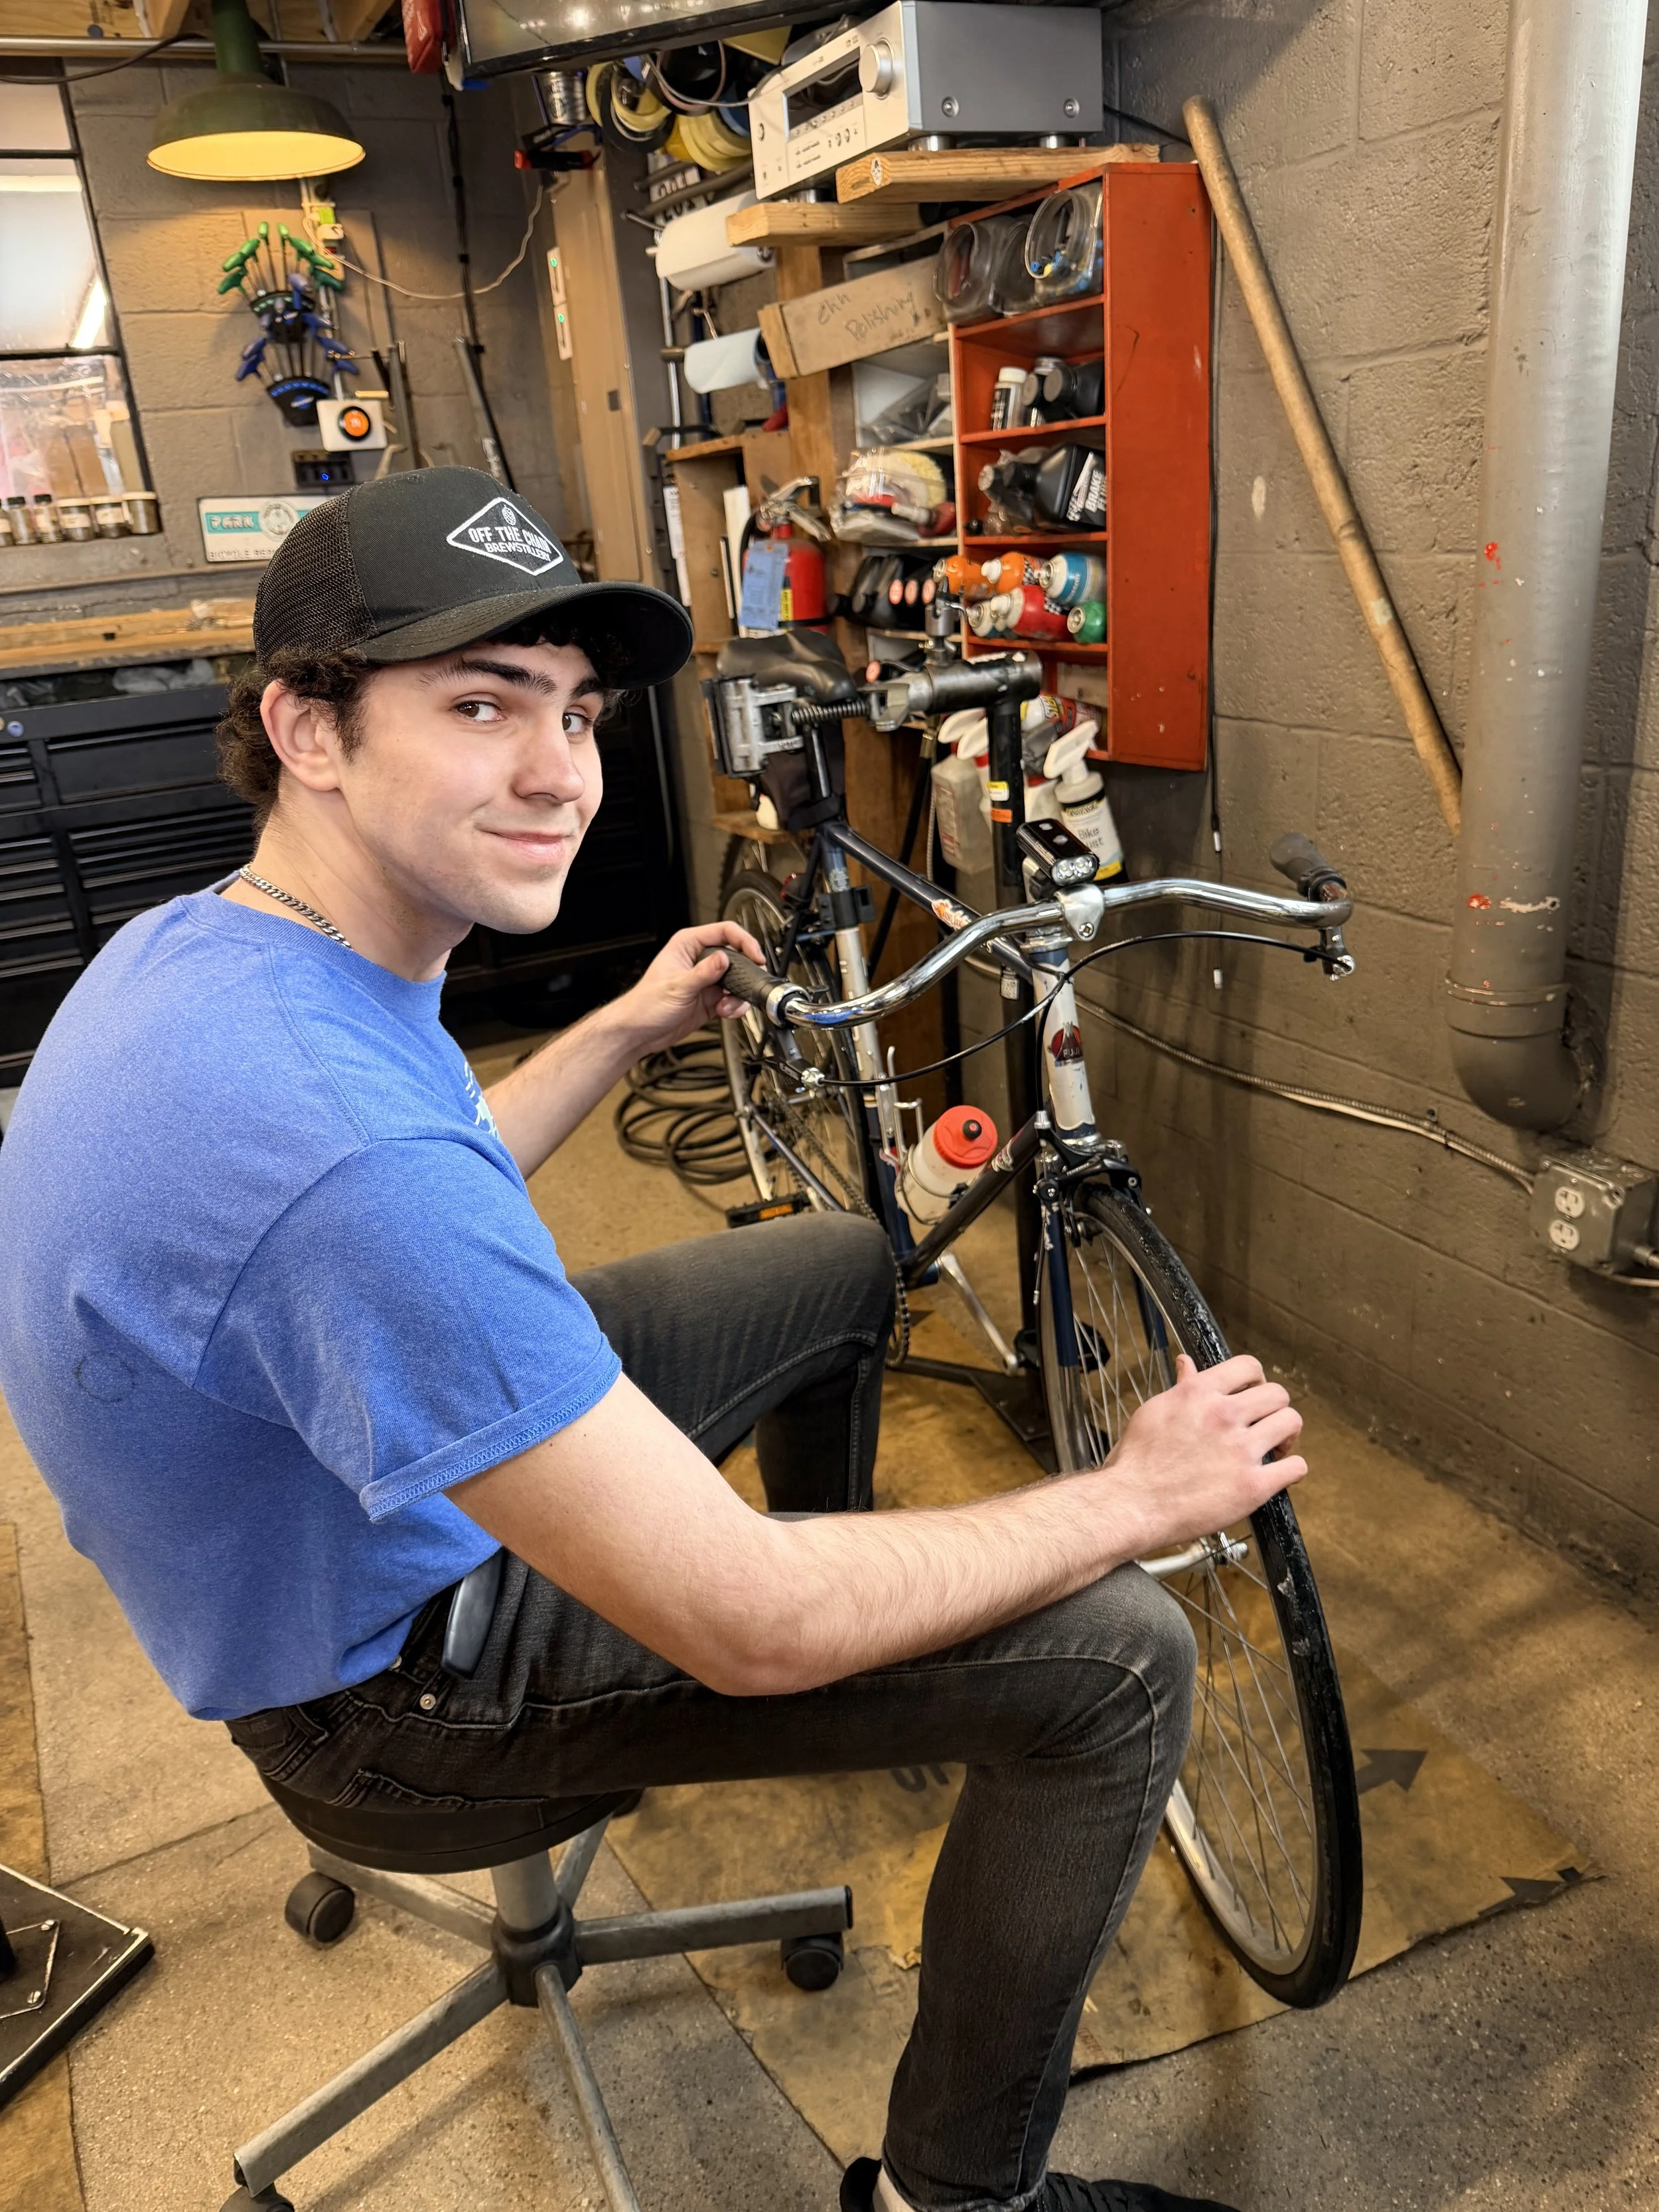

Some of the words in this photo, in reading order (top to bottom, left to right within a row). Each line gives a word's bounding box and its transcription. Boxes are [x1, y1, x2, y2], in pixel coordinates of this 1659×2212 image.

[1085, 469, 1102, 513] BRAKE
[210, 514, 254, 530] PARK
[468, 526, 492, 543] OFF
[494, 526, 524, 542] THE
[522, 529, 552, 554] CHAIN
[484, 542, 551, 562] BREWSTILLERY
[1078, 827, 1100, 840] Bike
[1086, 837, 1104, 849] ust
[1063, 1047, 1080, 1057] FUJI
